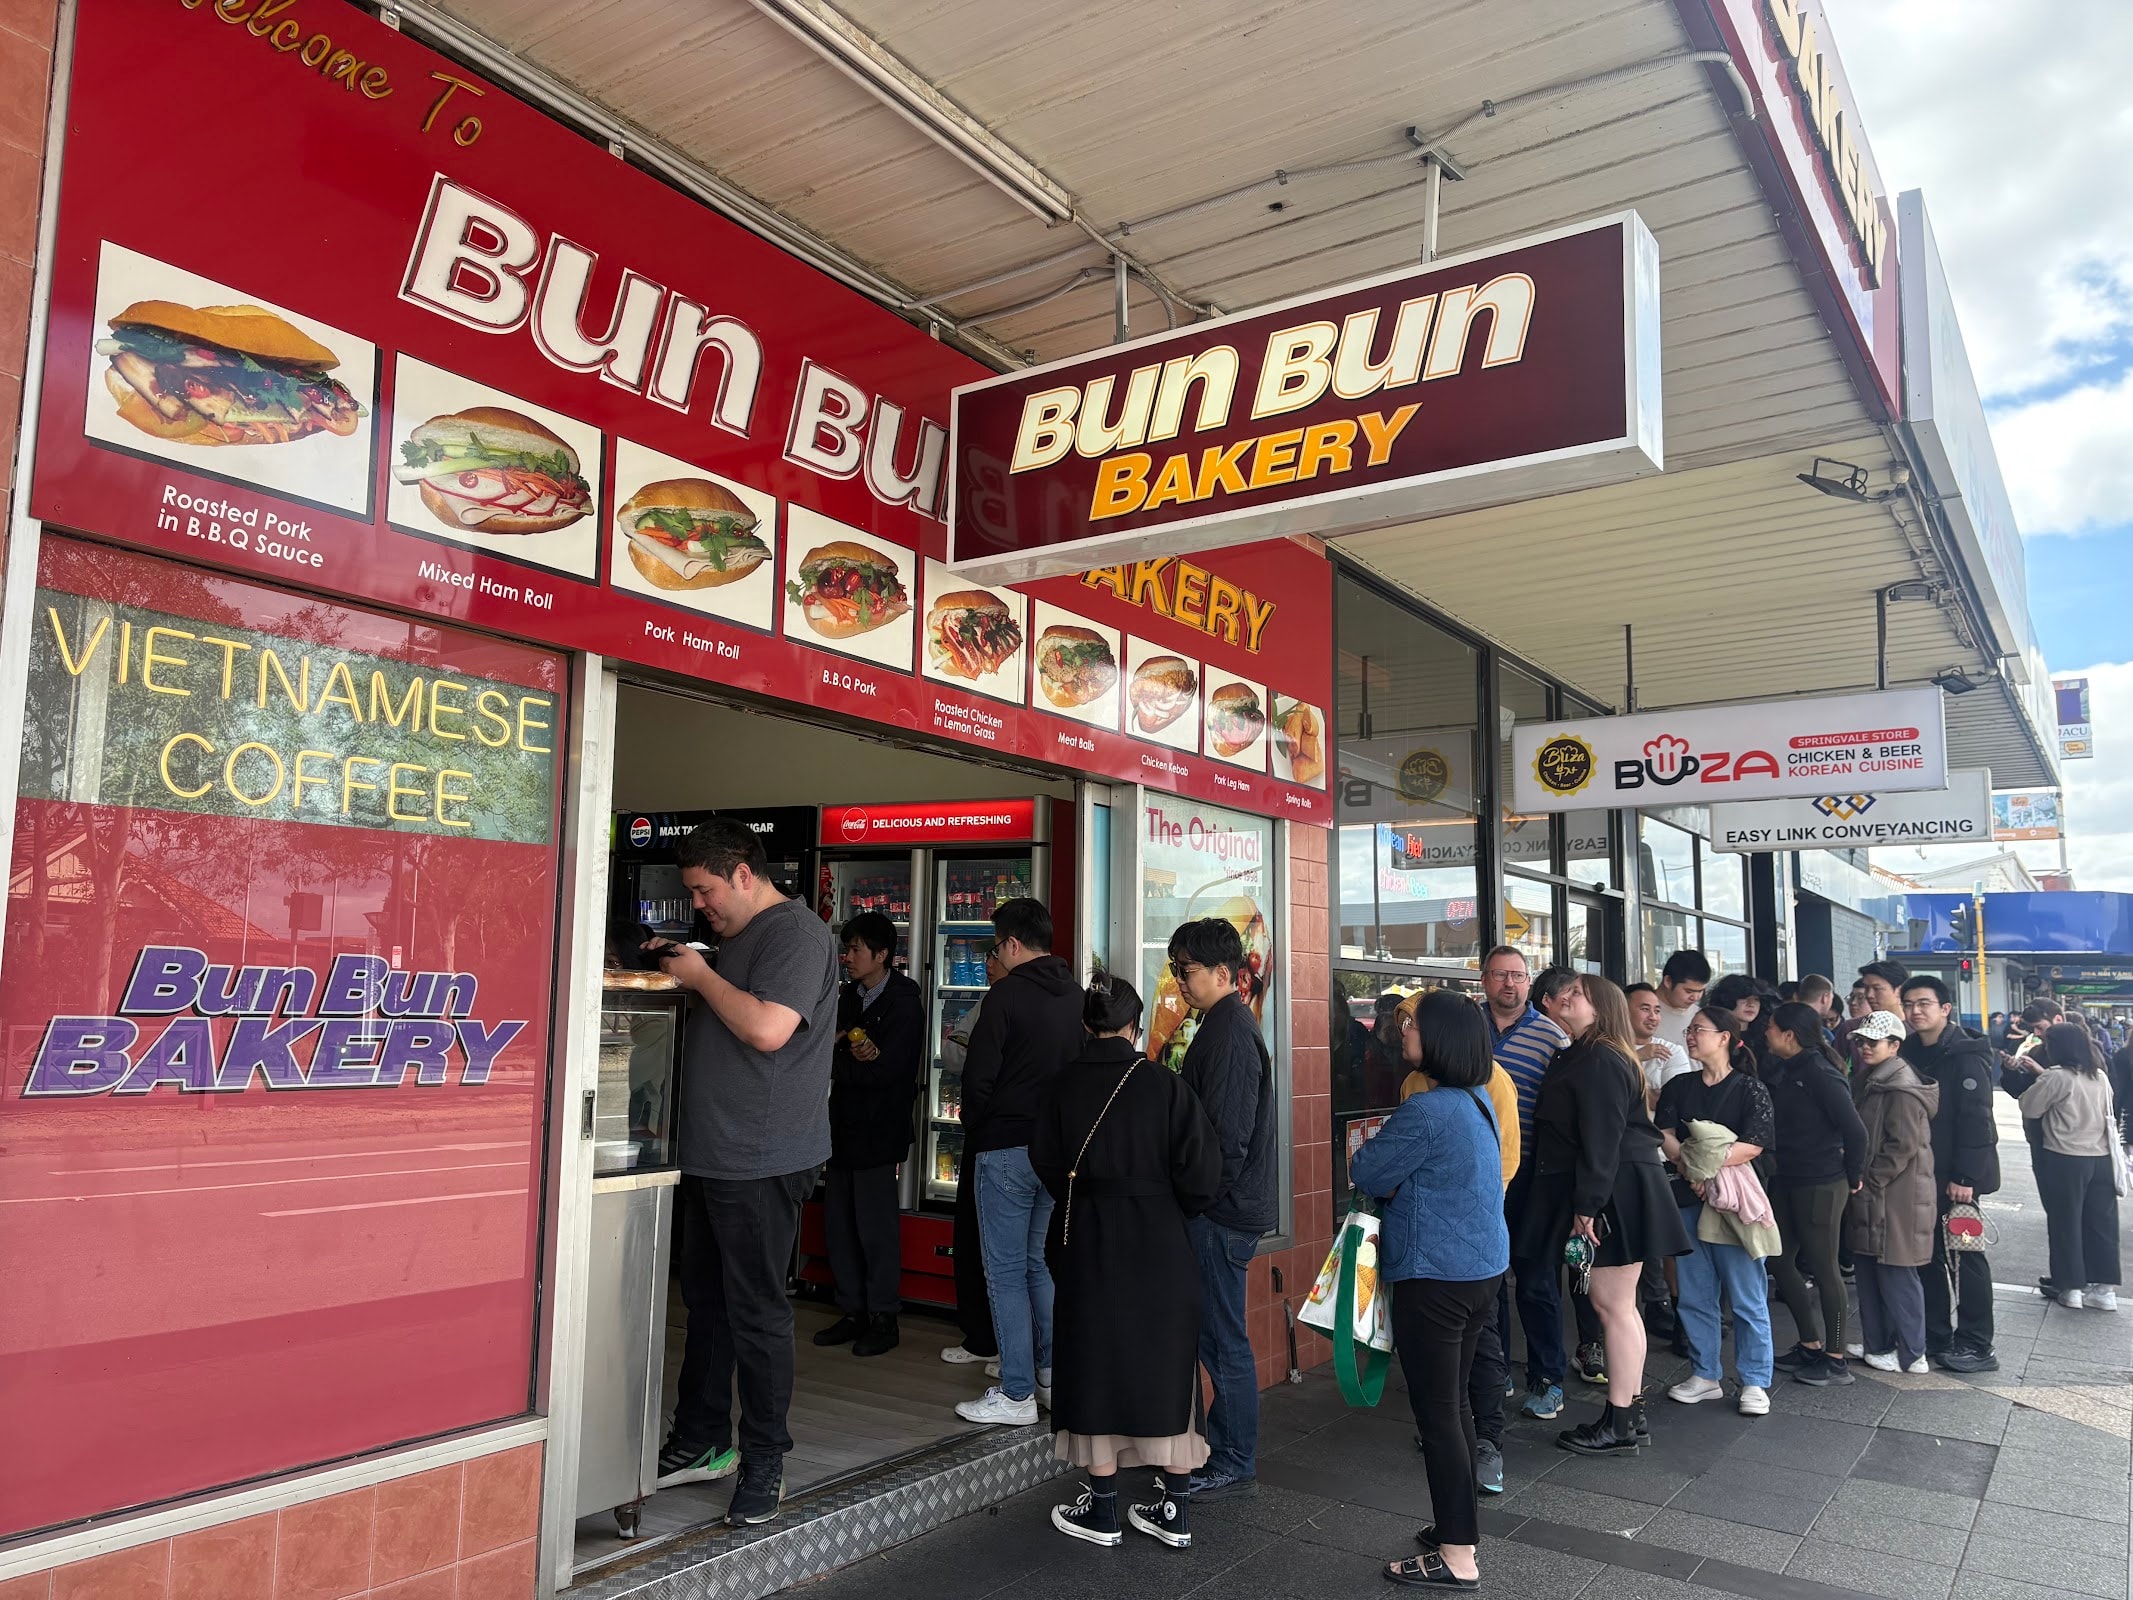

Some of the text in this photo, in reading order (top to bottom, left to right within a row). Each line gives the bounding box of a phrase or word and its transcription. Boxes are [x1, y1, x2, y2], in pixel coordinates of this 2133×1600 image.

[422, 71, 485, 146] To
[398, 171, 948, 523] Bun Bu
[1009, 272, 1536, 474] Bun Bun
[1088, 402, 1422, 521] BAKERY
[163, 485, 312, 541] Roasted Pork
[157, 508, 324, 567] in B.B.Q Sauce
[418, 560, 553, 610] Mixed Ham Roll
[1064, 556, 1277, 655] AKERY
[644, 621, 740, 660] Pork Ham Roll
[48, 606, 552, 754] VIETNAMESE
[822, 669, 877, 696] B.B.Q Pork
[934, 715, 995, 741] in Lemon Grass
[935, 699, 1002, 729] Roasted Chicken
[1057, 732, 1095, 752] Meat Balls
[1797, 729, 1910, 747] SPRINGVALE STORE
[1141, 754, 1189, 777] Chicken Kebab
[1787, 744, 1922, 765] CHICKEN & BEER
[1788, 757, 1924, 777] KOREAN CUISINE
[160, 732, 472, 828] COFFEE
[1214, 774, 1250, 792] Pork Leg Ham
[1285, 792, 1300, 808] Spring
[631, 828, 650, 836] PEPSI
[659, 826, 681, 837] MAX
[872, 815, 1012, 829] DELICIOUS AND REFRESHING
[1146, 807, 1259, 861] The Original
[1726, 818, 1973, 843] EASY LINK CONVEYANCING
[1446, 901, 1474, 918] OPEN
[117, 944, 477, 1018] Bun Bun
[22, 1014, 528, 1097] BAKERY
